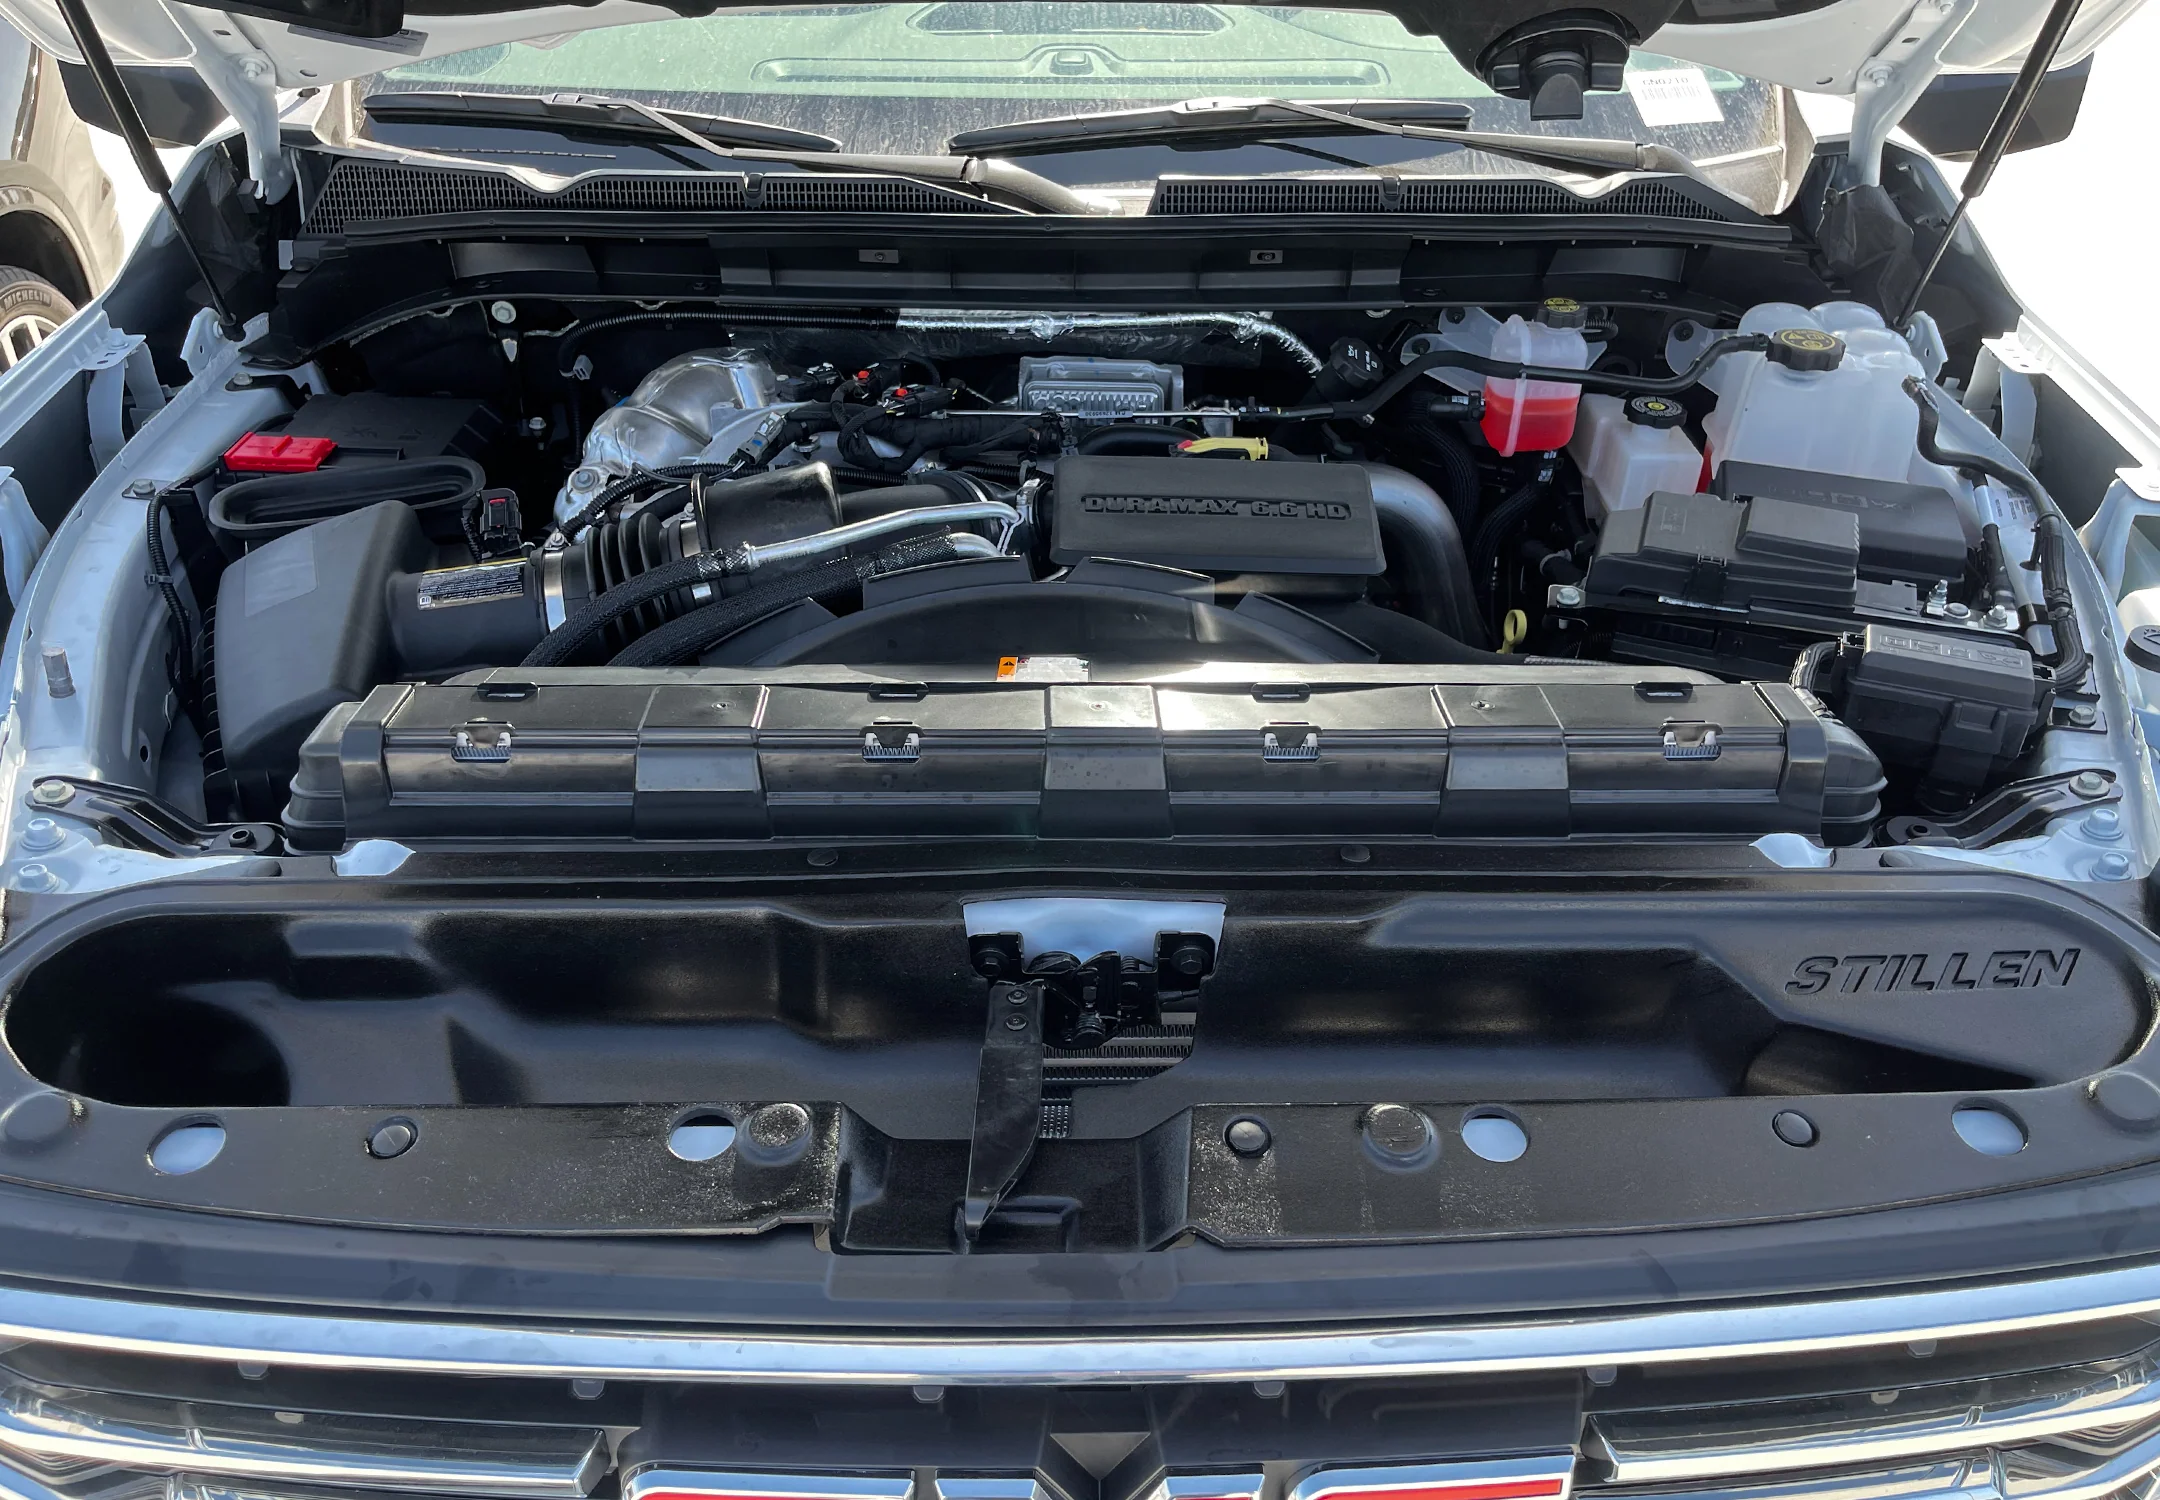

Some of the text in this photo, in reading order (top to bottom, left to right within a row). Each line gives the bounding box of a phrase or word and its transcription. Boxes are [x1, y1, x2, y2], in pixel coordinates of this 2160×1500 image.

[3, 289, 52, 310] MICHELIN
[1084, 496, 1349, 520] DURAMAX 6.6 HD
[1784, 948, 2081, 995] STILLEN
